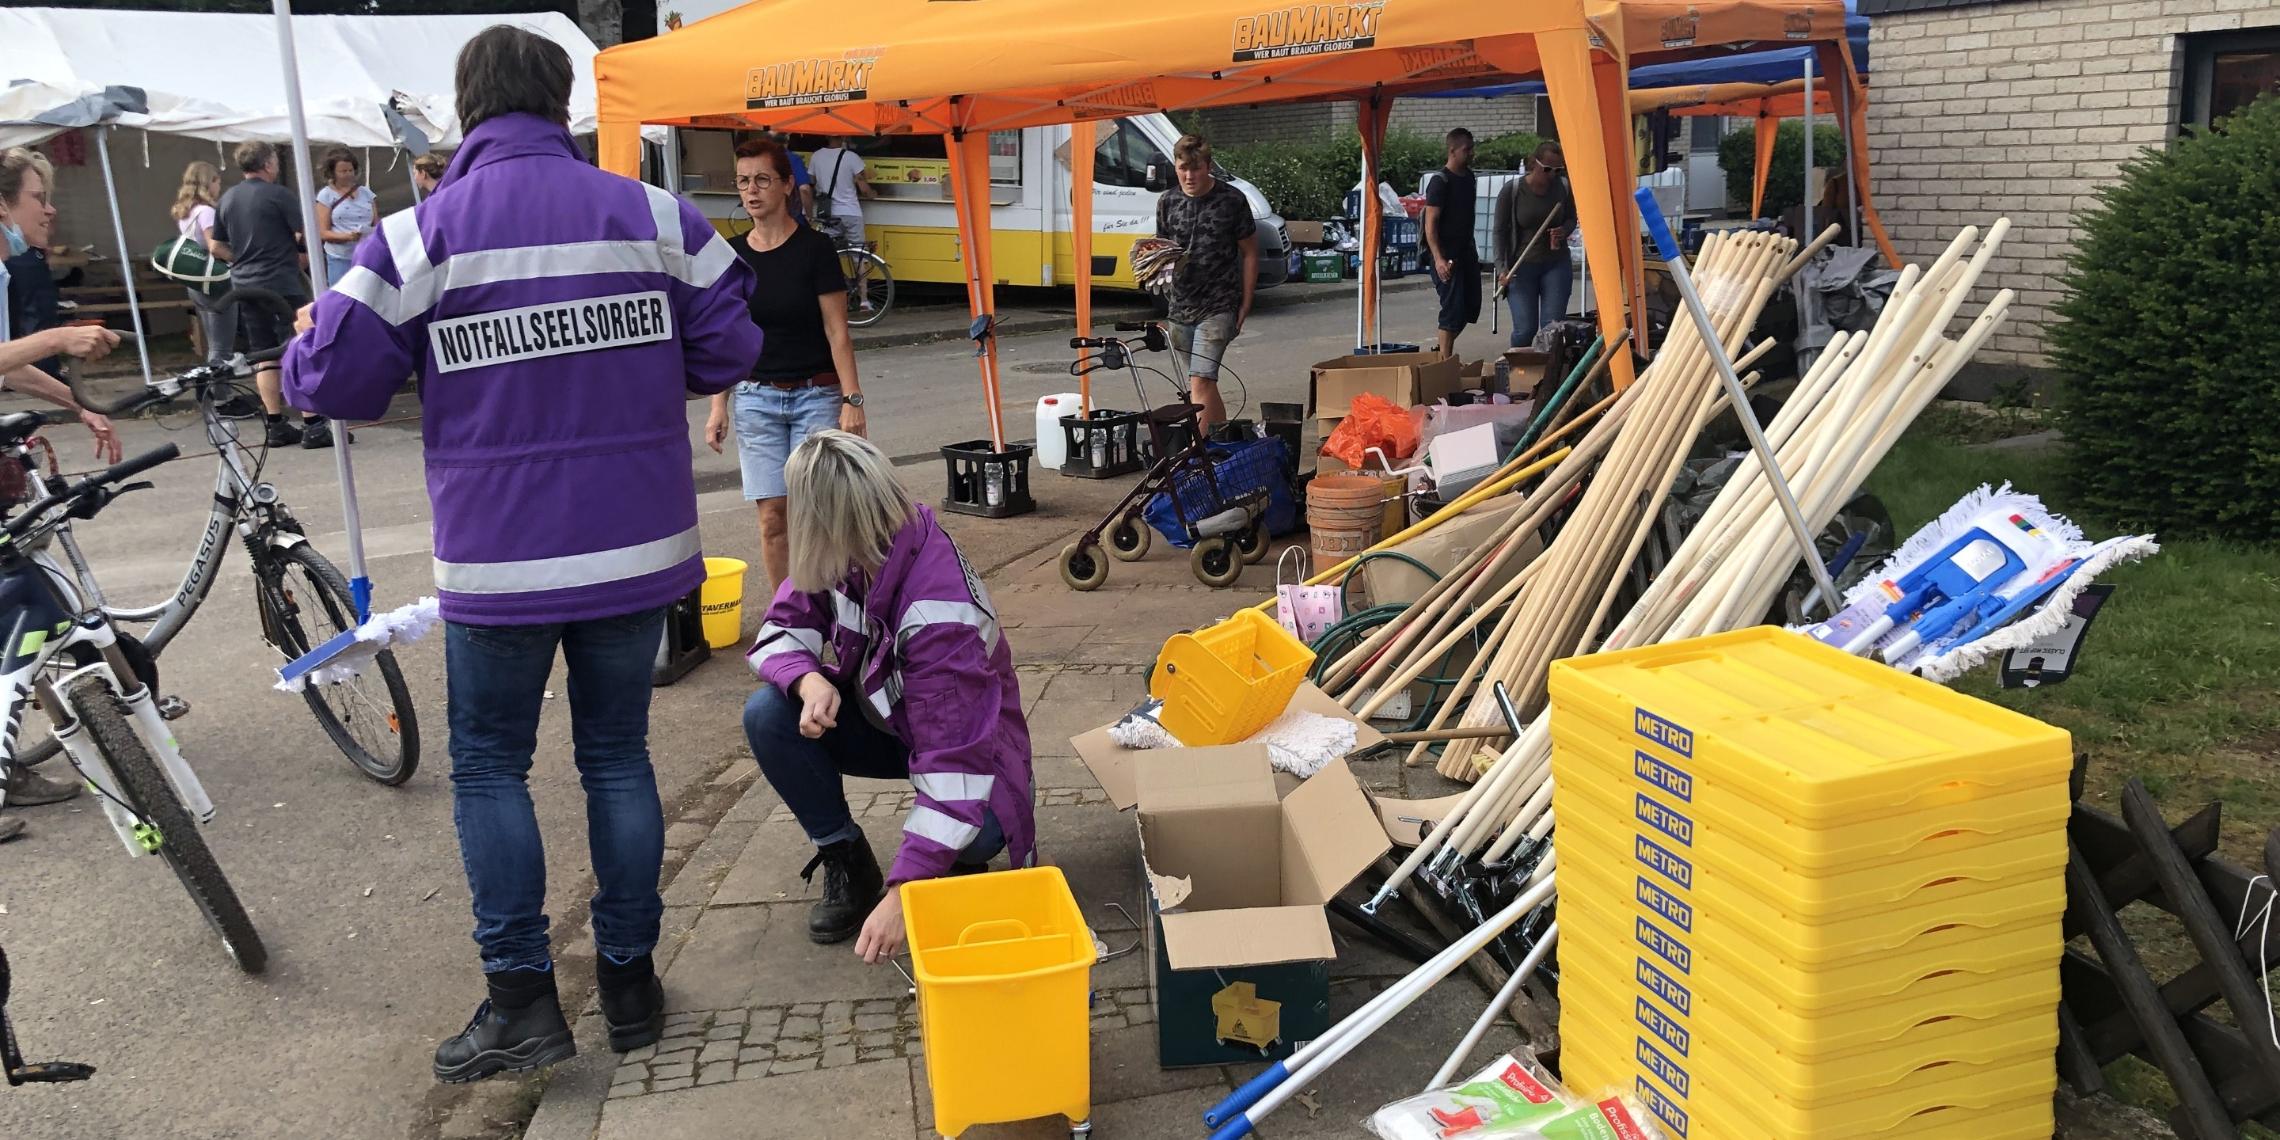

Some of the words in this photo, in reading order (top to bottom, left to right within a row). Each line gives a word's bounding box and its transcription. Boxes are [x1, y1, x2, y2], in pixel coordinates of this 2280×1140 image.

[1234, 5, 1383, 51] BAUMARKT
[1254, 51, 1269, 59] WER
[1271, 48, 1289, 57] BAUT
[1291, 44, 1322, 55] BRAUCHT
[1324, 41, 1354, 52] GLOBUS!
[747, 59, 874, 99] BAUMARKT
[764, 99, 778, 107] WER
[779, 97, 795, 106] BAUT
[796, 95, 823, 105] BRAUCHT
[824, 93, 849, 103] GLOBUS!
[438, 298, 665, 366] NOTFALLSEELSORGER
[177, 517, 220, 607] PEGASUS
[1637, 713, 1690, 753] METRO
[1637, 756, 1689, 797] METRO
[1638, 798, 1690, 841] METRO
[1638, 840, 1689, 883] METRO
[1639, 881, 1689, 928] METRO
[1638, 922, 1689, 969] METRO
[1638, 962, 1688, 1011] METRO
[1638, 1002, 1687, 1052] METRO
[1638, 1042, 1687, 1094] METRO
[1638, 1081, 1687, 1135] METRO
